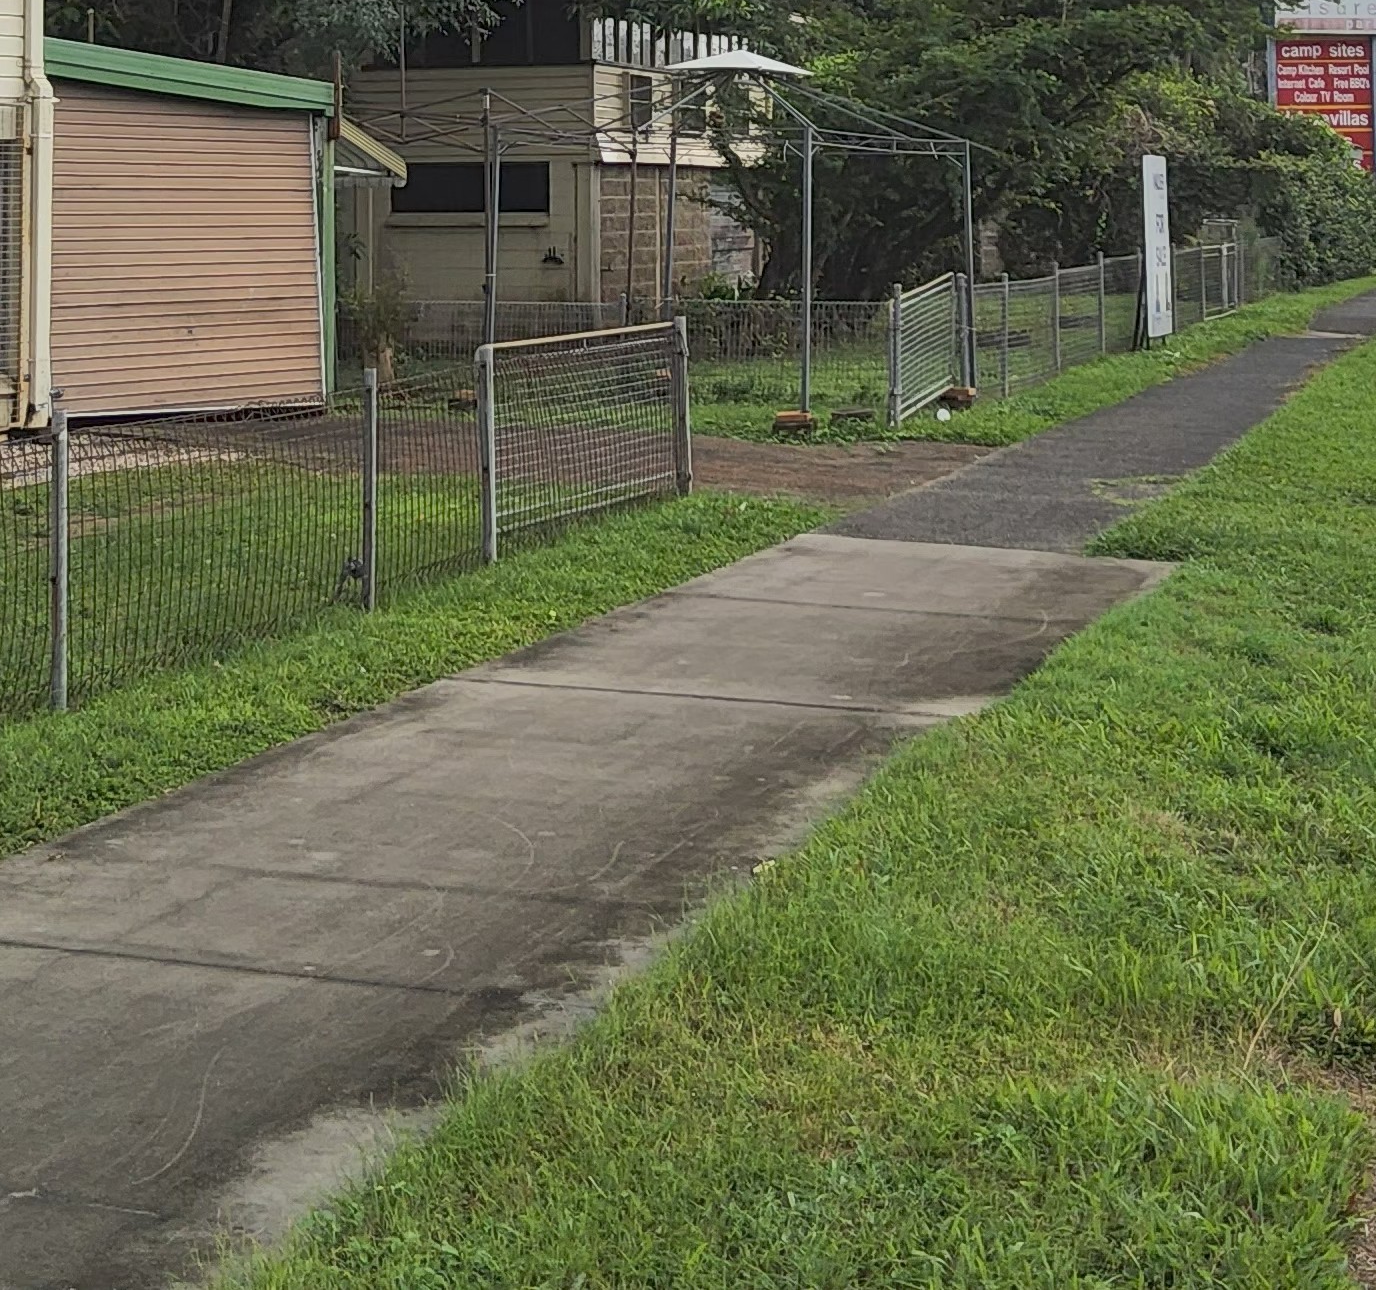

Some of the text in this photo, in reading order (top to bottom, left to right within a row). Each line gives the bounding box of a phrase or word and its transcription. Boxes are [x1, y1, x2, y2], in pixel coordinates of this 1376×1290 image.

[1281, 42, 1365, 59] camp sites
[1319, 90, 1332, 103] TV
